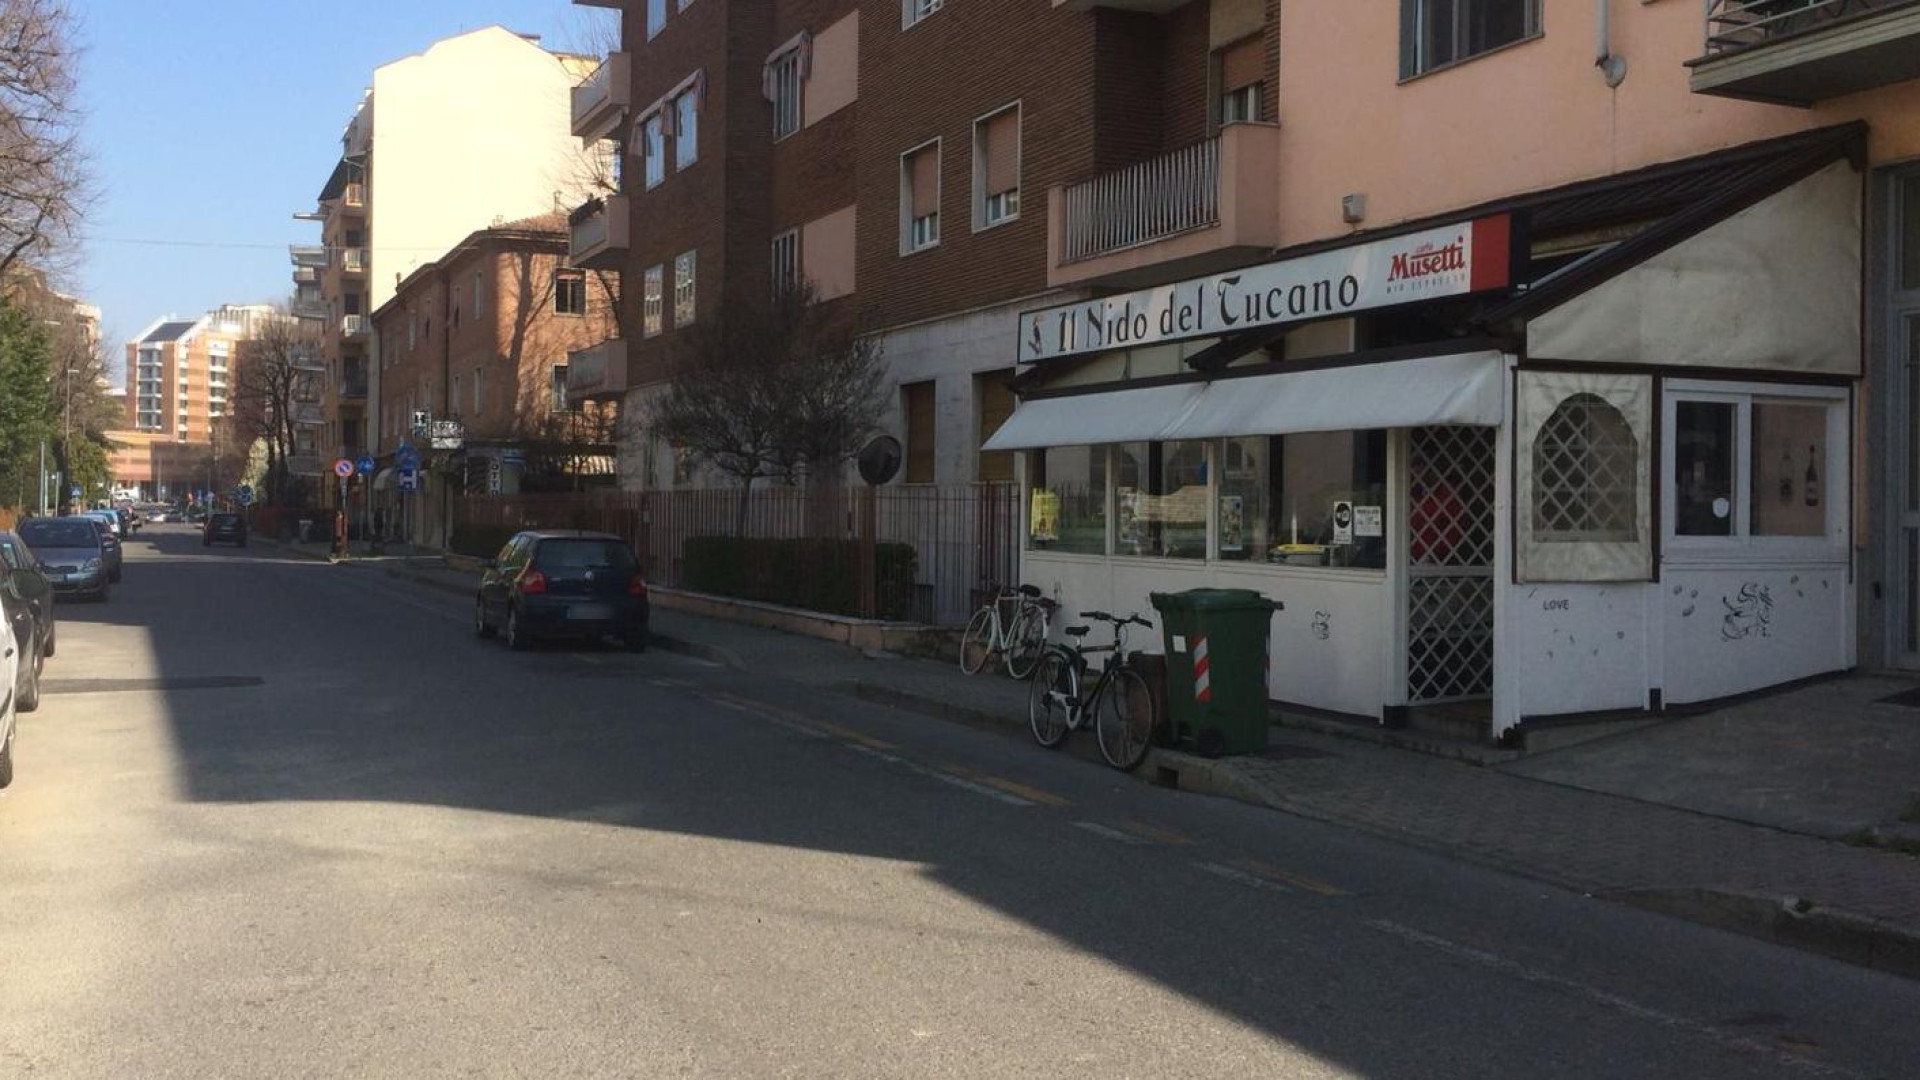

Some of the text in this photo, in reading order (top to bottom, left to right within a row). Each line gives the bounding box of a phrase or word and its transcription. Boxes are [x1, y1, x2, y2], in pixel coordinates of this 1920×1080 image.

[1387, 235, 1466, 282] Musetti
[1059, 275, 1360, 352] Il Nido del Tucano
[1542, 599, 1570, 611] LOVE
